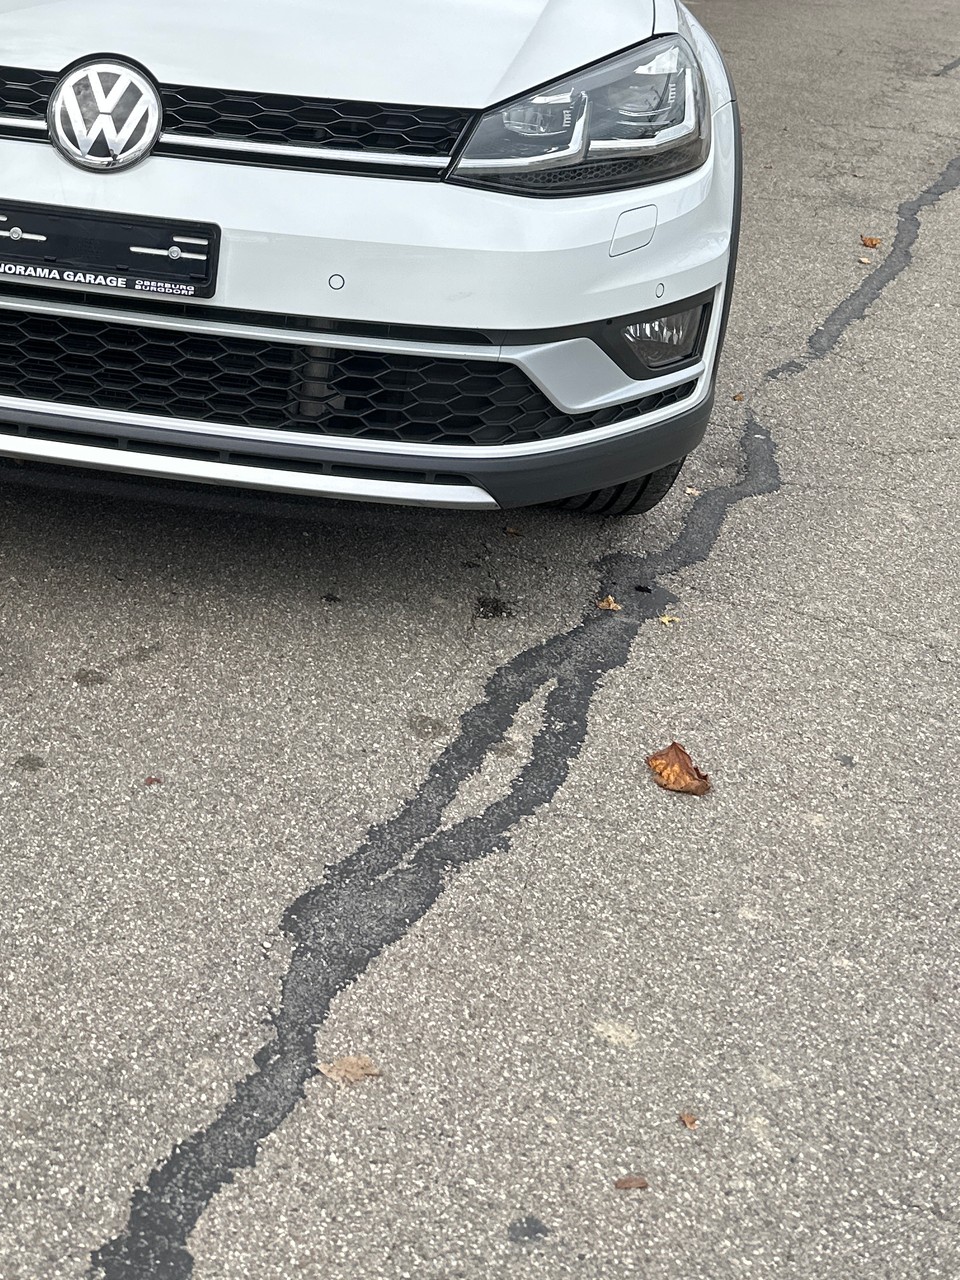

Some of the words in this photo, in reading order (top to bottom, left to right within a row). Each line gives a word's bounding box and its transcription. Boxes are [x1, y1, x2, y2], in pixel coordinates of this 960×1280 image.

[54, 65, 156, 164] VW
[63, 271, 127, 288] GARAGE
[135, 280, 195, 290] OBERBURG
[135, 285, 195, 295] BURGDORF
